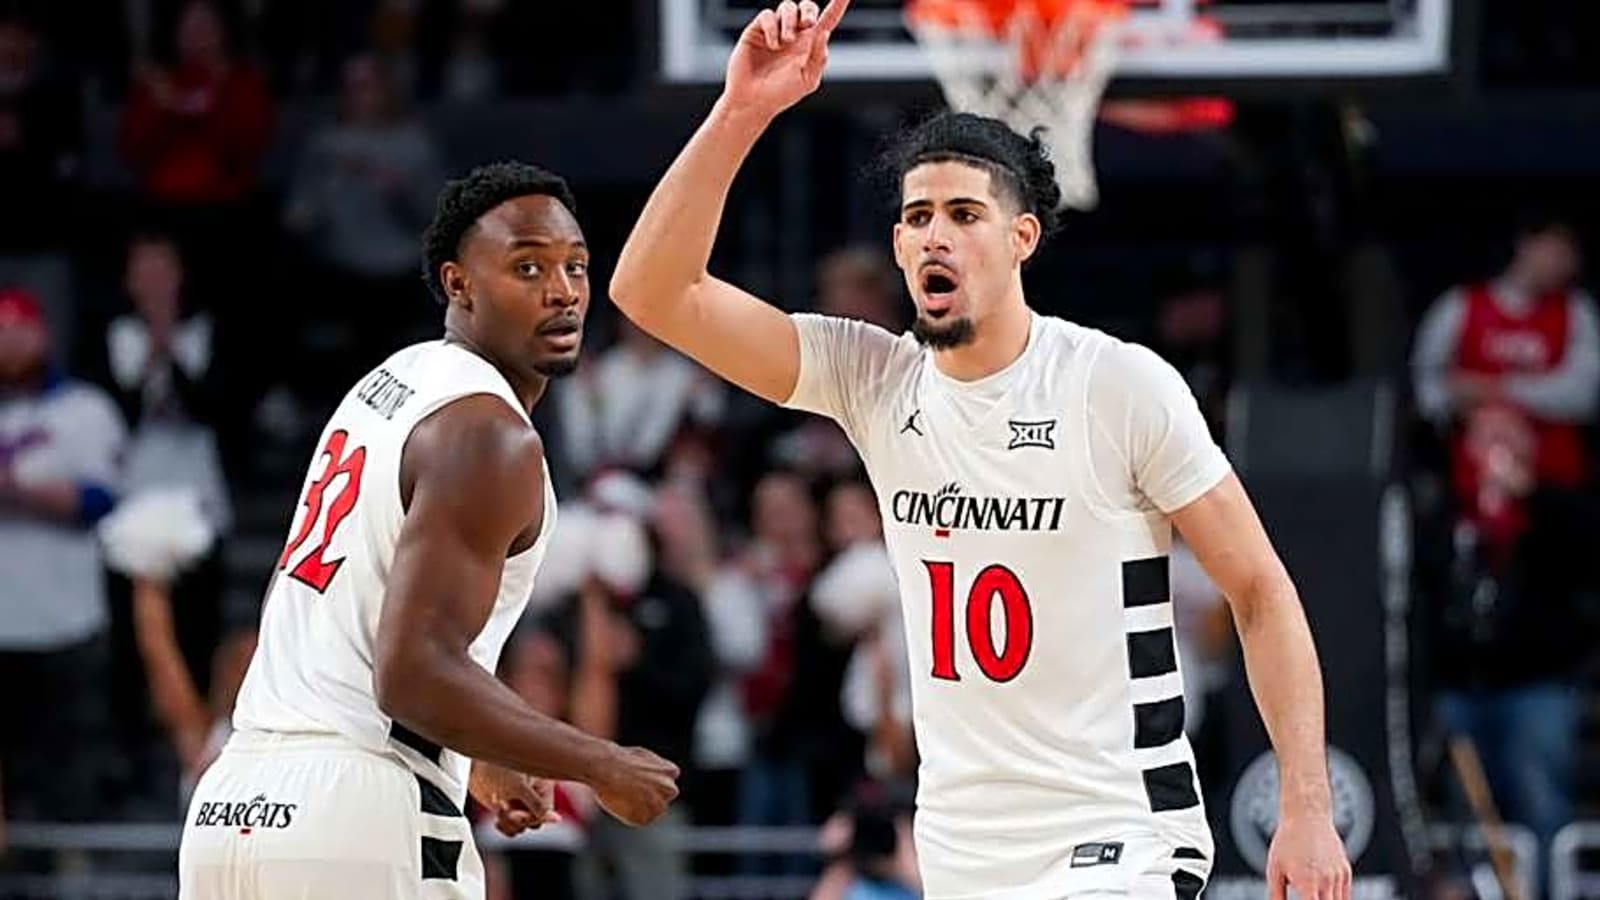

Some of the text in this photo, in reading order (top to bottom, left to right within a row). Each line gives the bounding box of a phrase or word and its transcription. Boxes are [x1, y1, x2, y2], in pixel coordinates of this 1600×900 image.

[280, 428, 367, 594] 32
[892, 486, 1066, 533] CINCINNATI
[921, 558, 1034, 684] 10
[194, 800, 298, 830] BEARCATS
